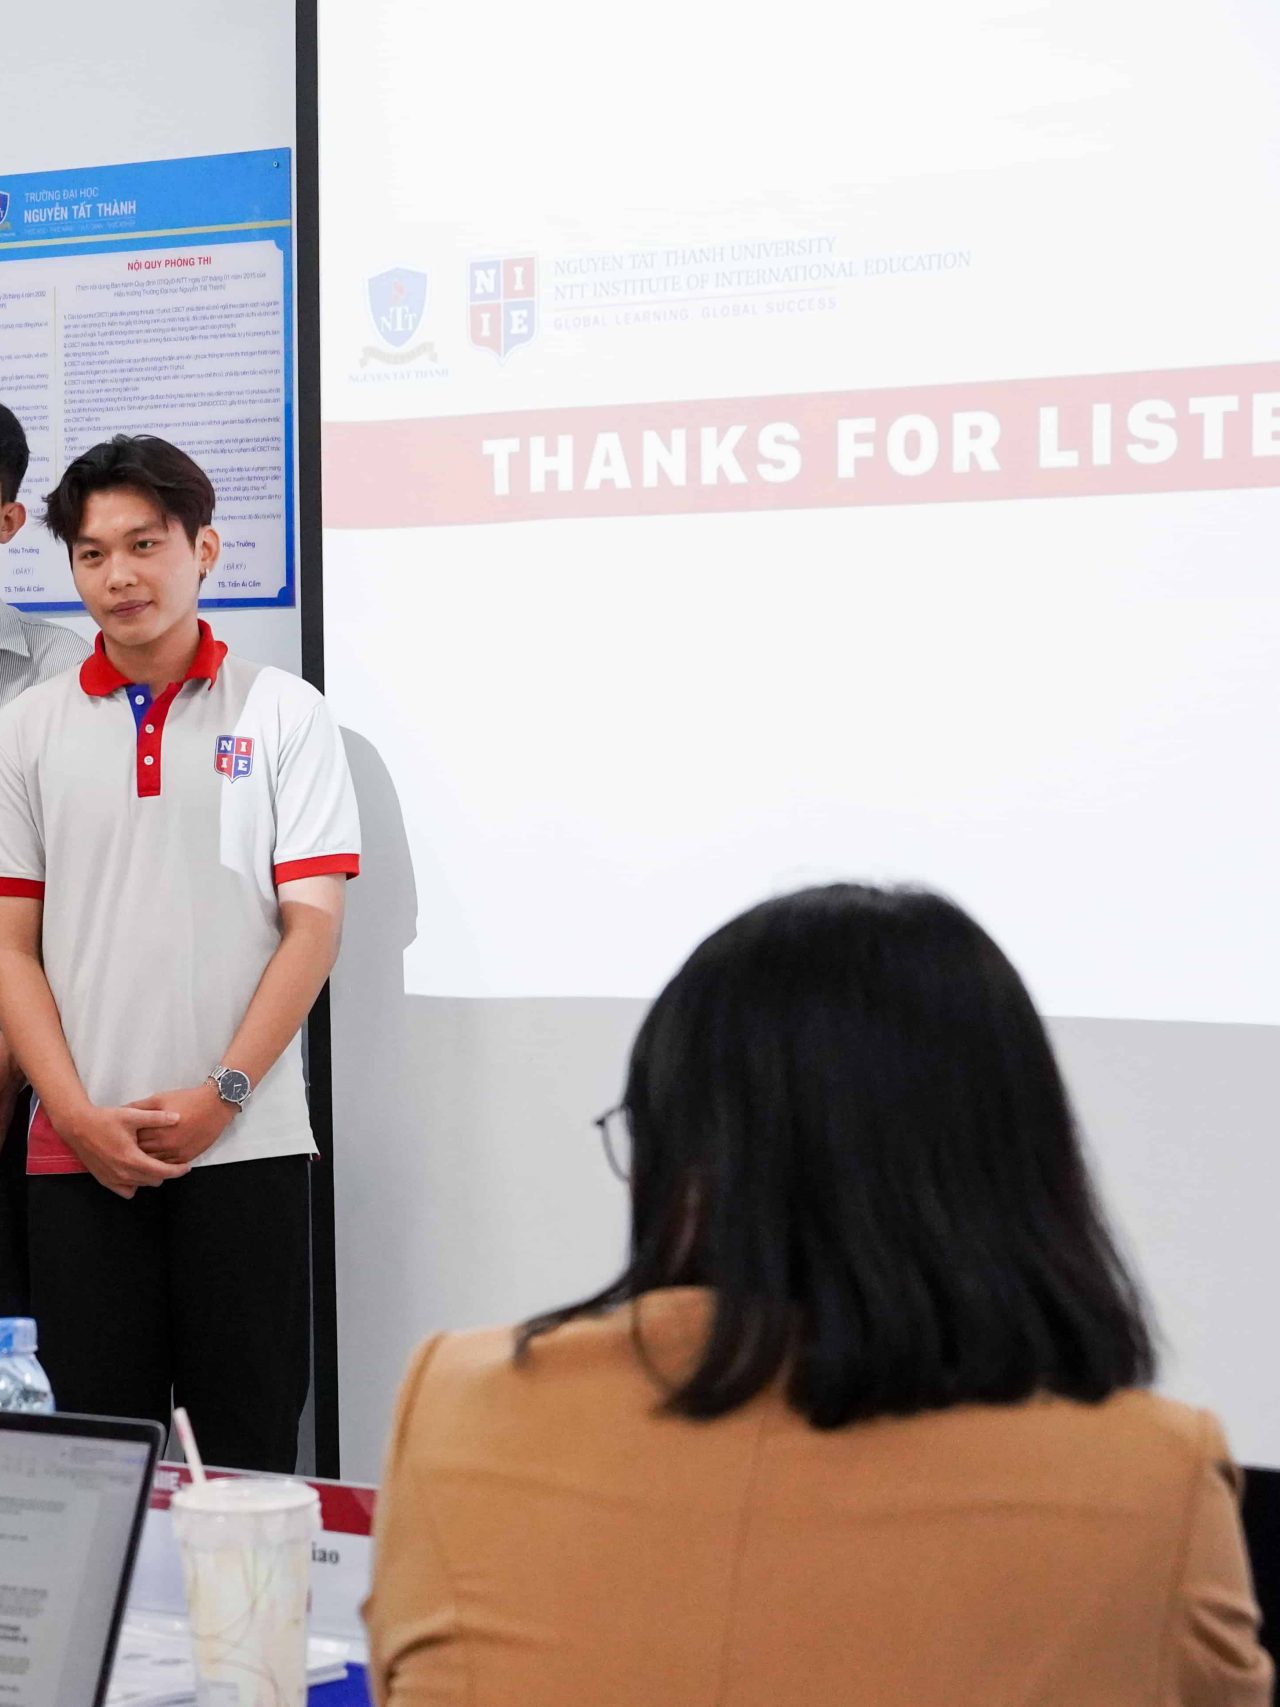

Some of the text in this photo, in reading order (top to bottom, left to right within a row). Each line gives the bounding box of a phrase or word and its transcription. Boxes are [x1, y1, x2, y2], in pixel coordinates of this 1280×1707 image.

[80, 187, 98, 199] HỌC
[24, 199, 136, 223] NGUYỄN TẤT THÀNH
[127, 256, 212, 271] NỘI QUY PHÒNG THI
[553, 235, 837, 277] NGUYEN TAT THANH UNIVERSITY
[553, 250, 971, 301] NTT INSTITUTE OF INTERNATIONAL EDUCATION
[553, 314, 608, 332] GLOBAL
[701, 303, 759, 319] GLOBAL
[766, 296, 837, 314] SUCCESS
[481, 391, 1280, 496] THANKS FOR LISTE
[311, 1541, 340, 1565] iao
